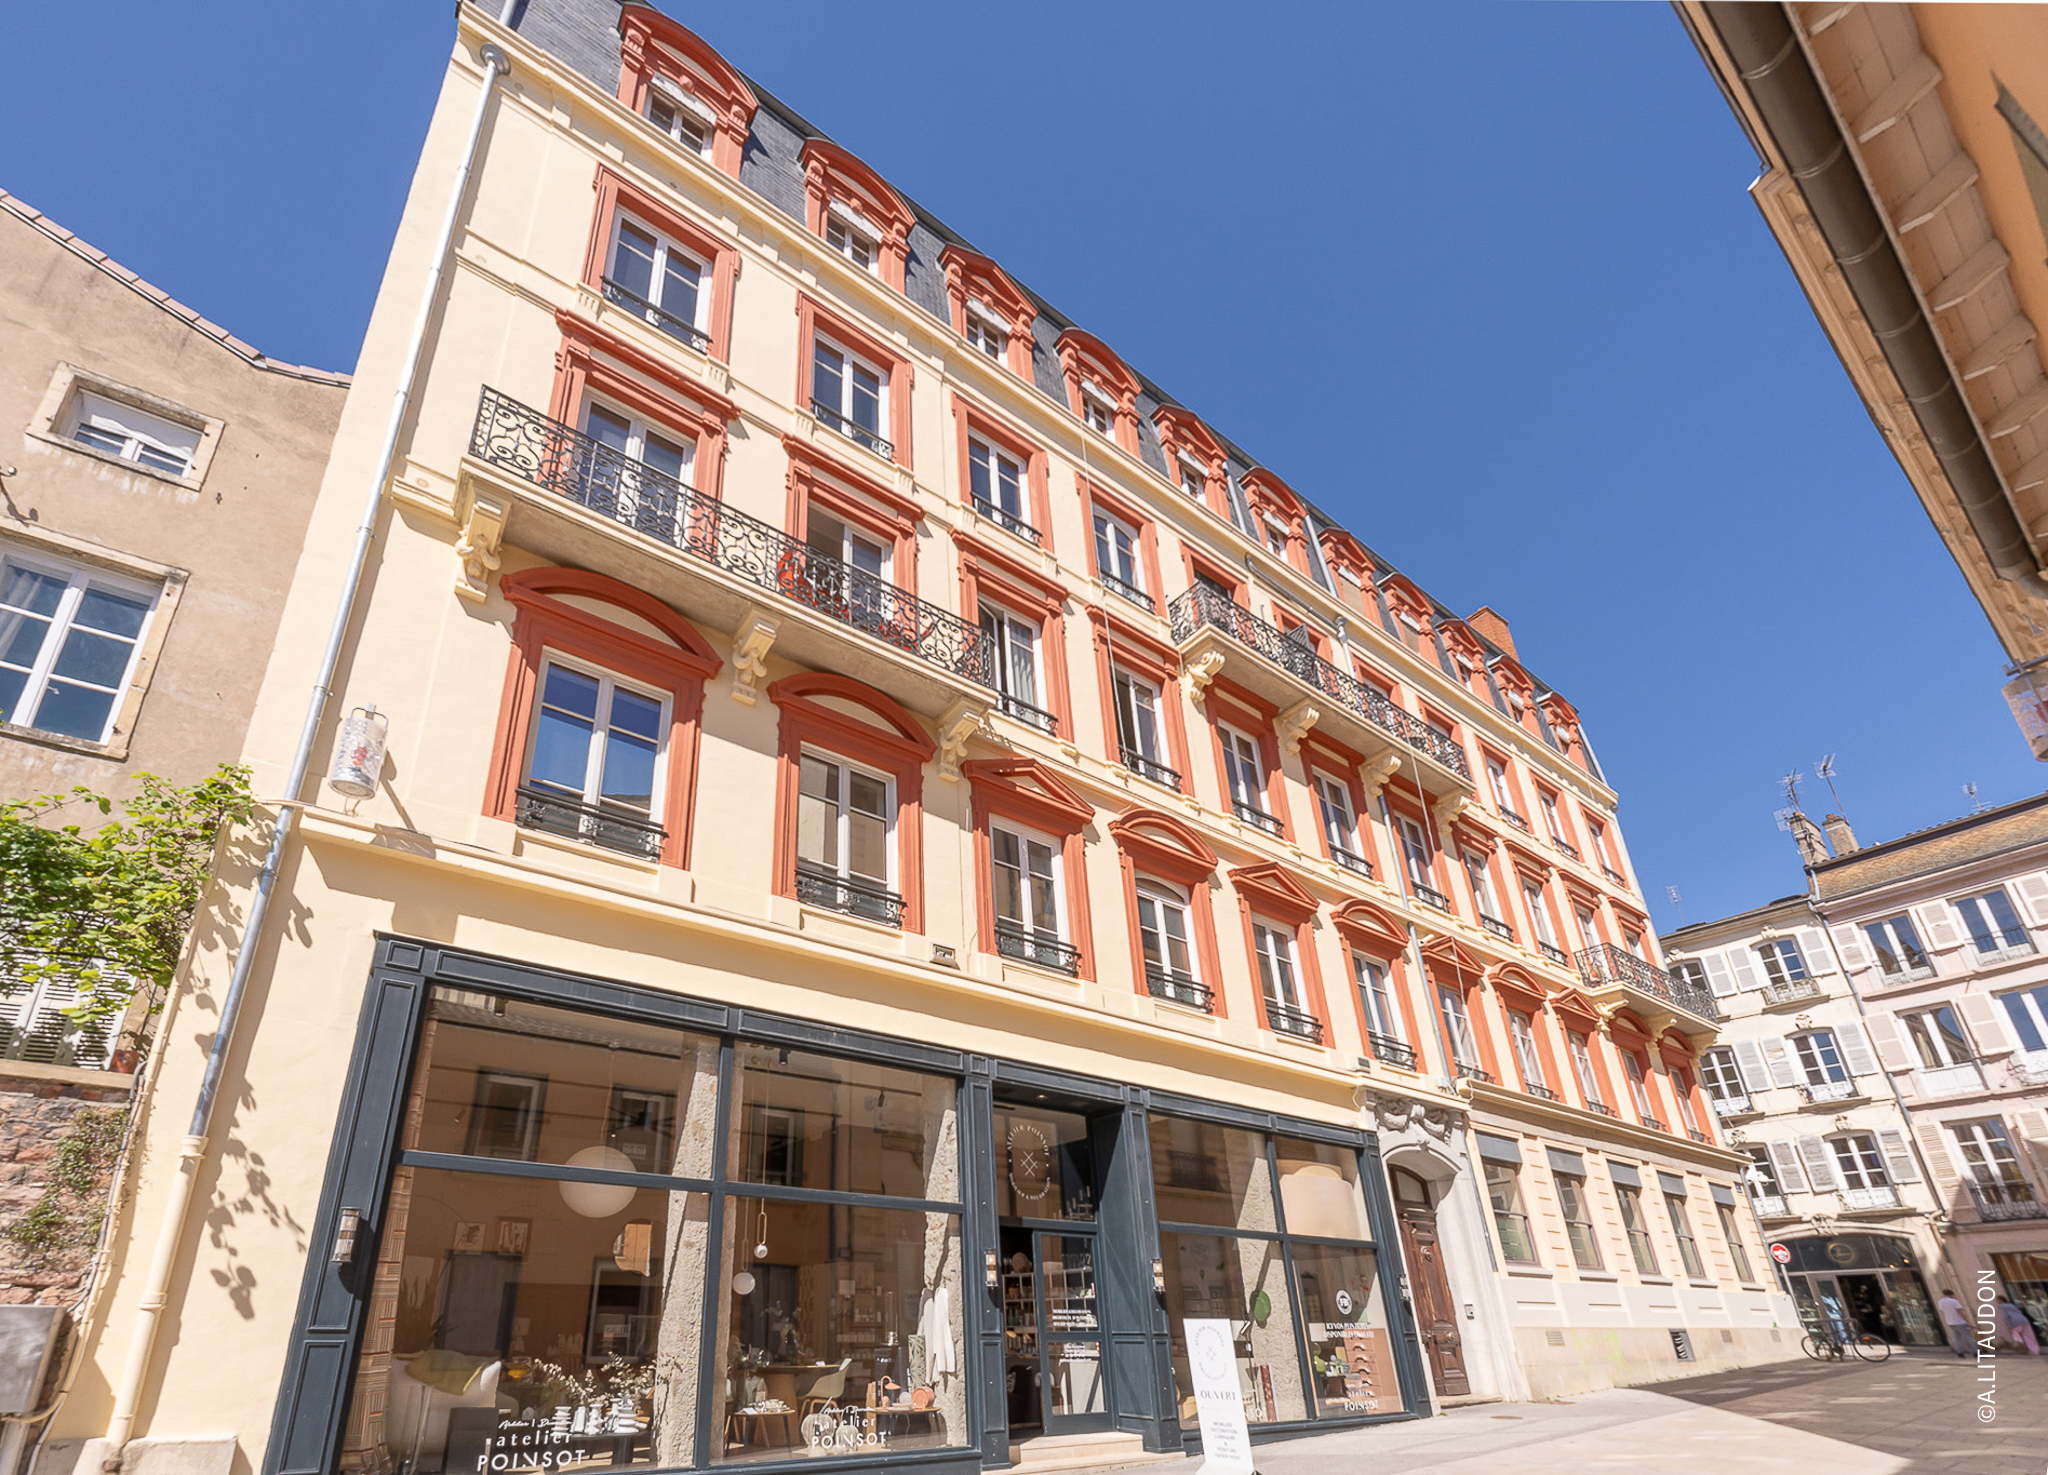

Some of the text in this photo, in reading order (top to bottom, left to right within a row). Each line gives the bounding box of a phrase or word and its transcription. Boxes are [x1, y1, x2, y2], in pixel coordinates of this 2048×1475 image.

[1200, 1389, 1236, 1401] OUVERT
[823, 1414, 876, 1429] atelier
[496, 1430, 572, 1447] atelier
[811, 1431, 887, 1450] POINSOT
[476, 1449, 586, 1472] POINSOT
